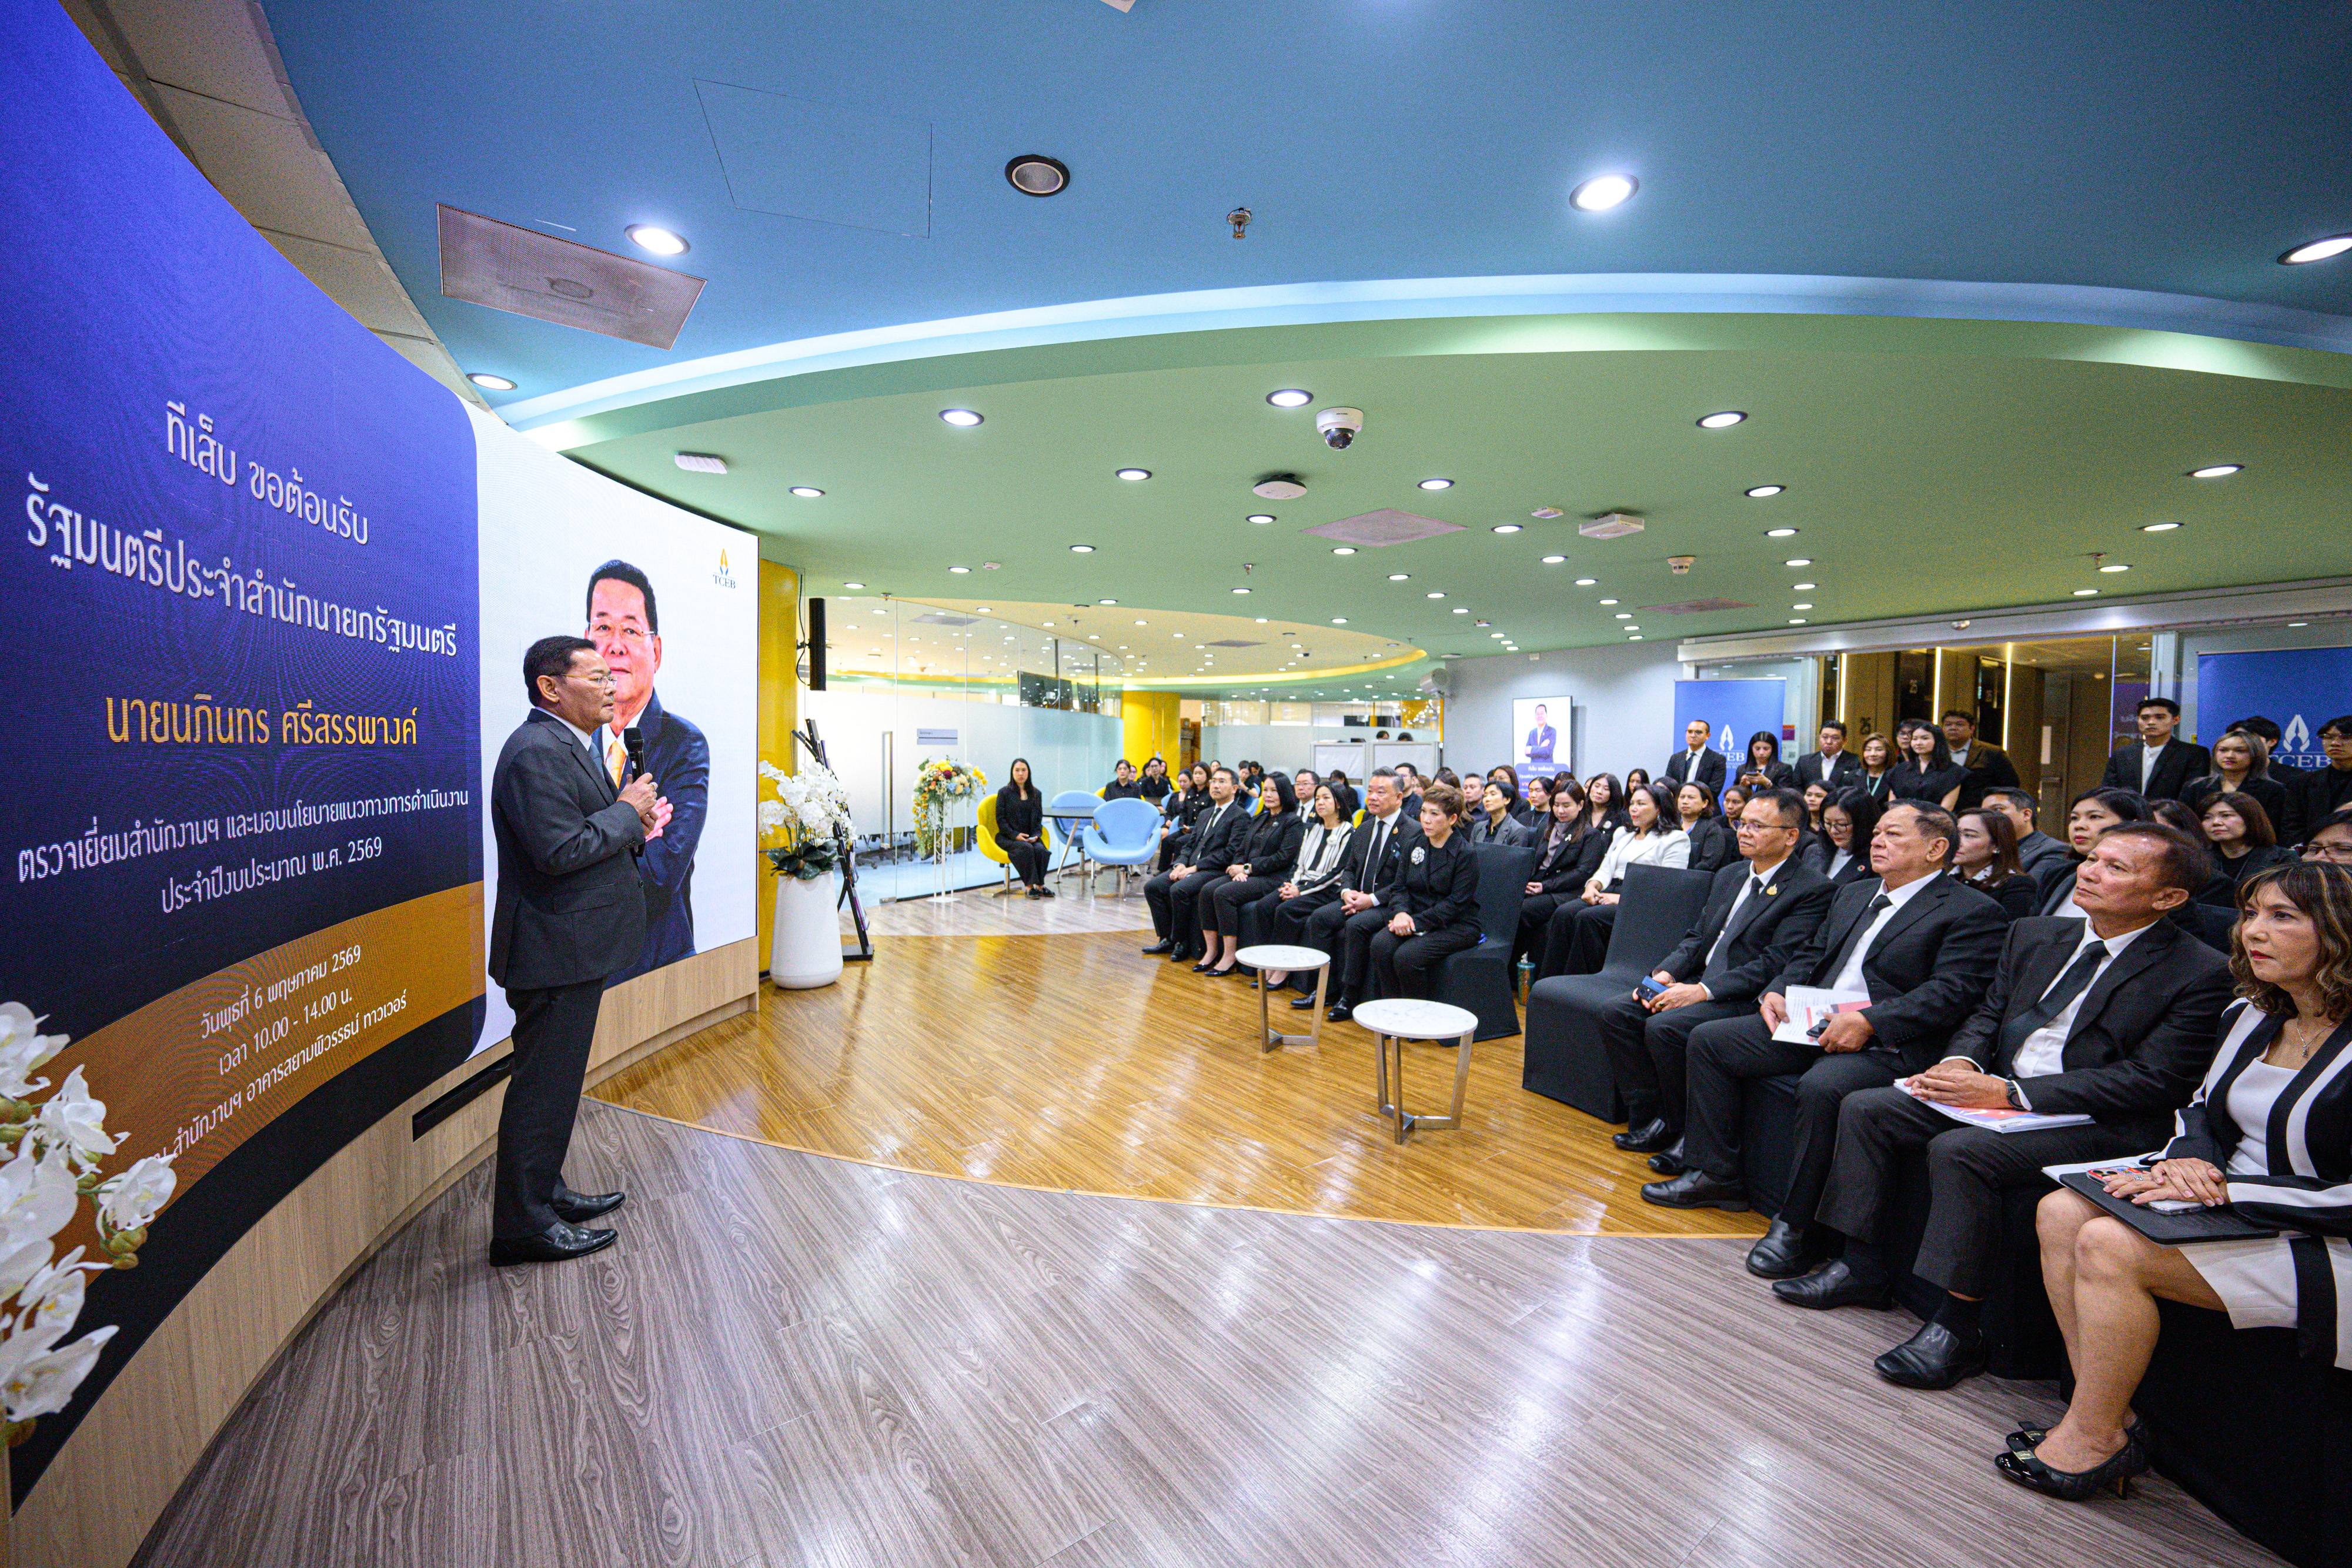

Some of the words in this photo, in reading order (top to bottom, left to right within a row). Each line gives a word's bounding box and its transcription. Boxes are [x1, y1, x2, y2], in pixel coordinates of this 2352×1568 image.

[167, 400, 236, 486] ทีเส็บ
[249, 461, 369, 545] ขอต้อนรับ
[26, 472, 457, 657] รัฐมนตรีประจำสำนักนายกรัฐมนตรี
[713, 574, 736, 589] TCEB
[106, 693, 270, 744] นายนภินทร
[282, 699, 417, 744] ศรีสรรพางค์
[19, 816, 219, 883] ตรวจเยี่ยมสำนักงานฯ
[227, 788, 469, 839] และมอบนโยบายแนวทางการดำเนินงาน
[162, 855, 306, 914] ประจำปีงบประมาณ
[312, 848, 342, 872] พ.ศ.
[348, 836, 383, 864] 2569
[201, 985, 249, 1039] วันพุธที่
[255, 987, 263, 1009] 6
[268, 961, 328, 1003] พฤษภาคม
[332, 944, 361, 973] 2569
[219, 1044, 248, 1076] เวลา
[254, 1016, 289, 1053] 10.00
[304, 991, 337, 1024] 14.00
[341, 988, 353, 1005] น.
[247, 1012, 360, 1102] อาคารสยามพิวรรธน์
[363, 988, 407, 1029] ทาวเวอร์
